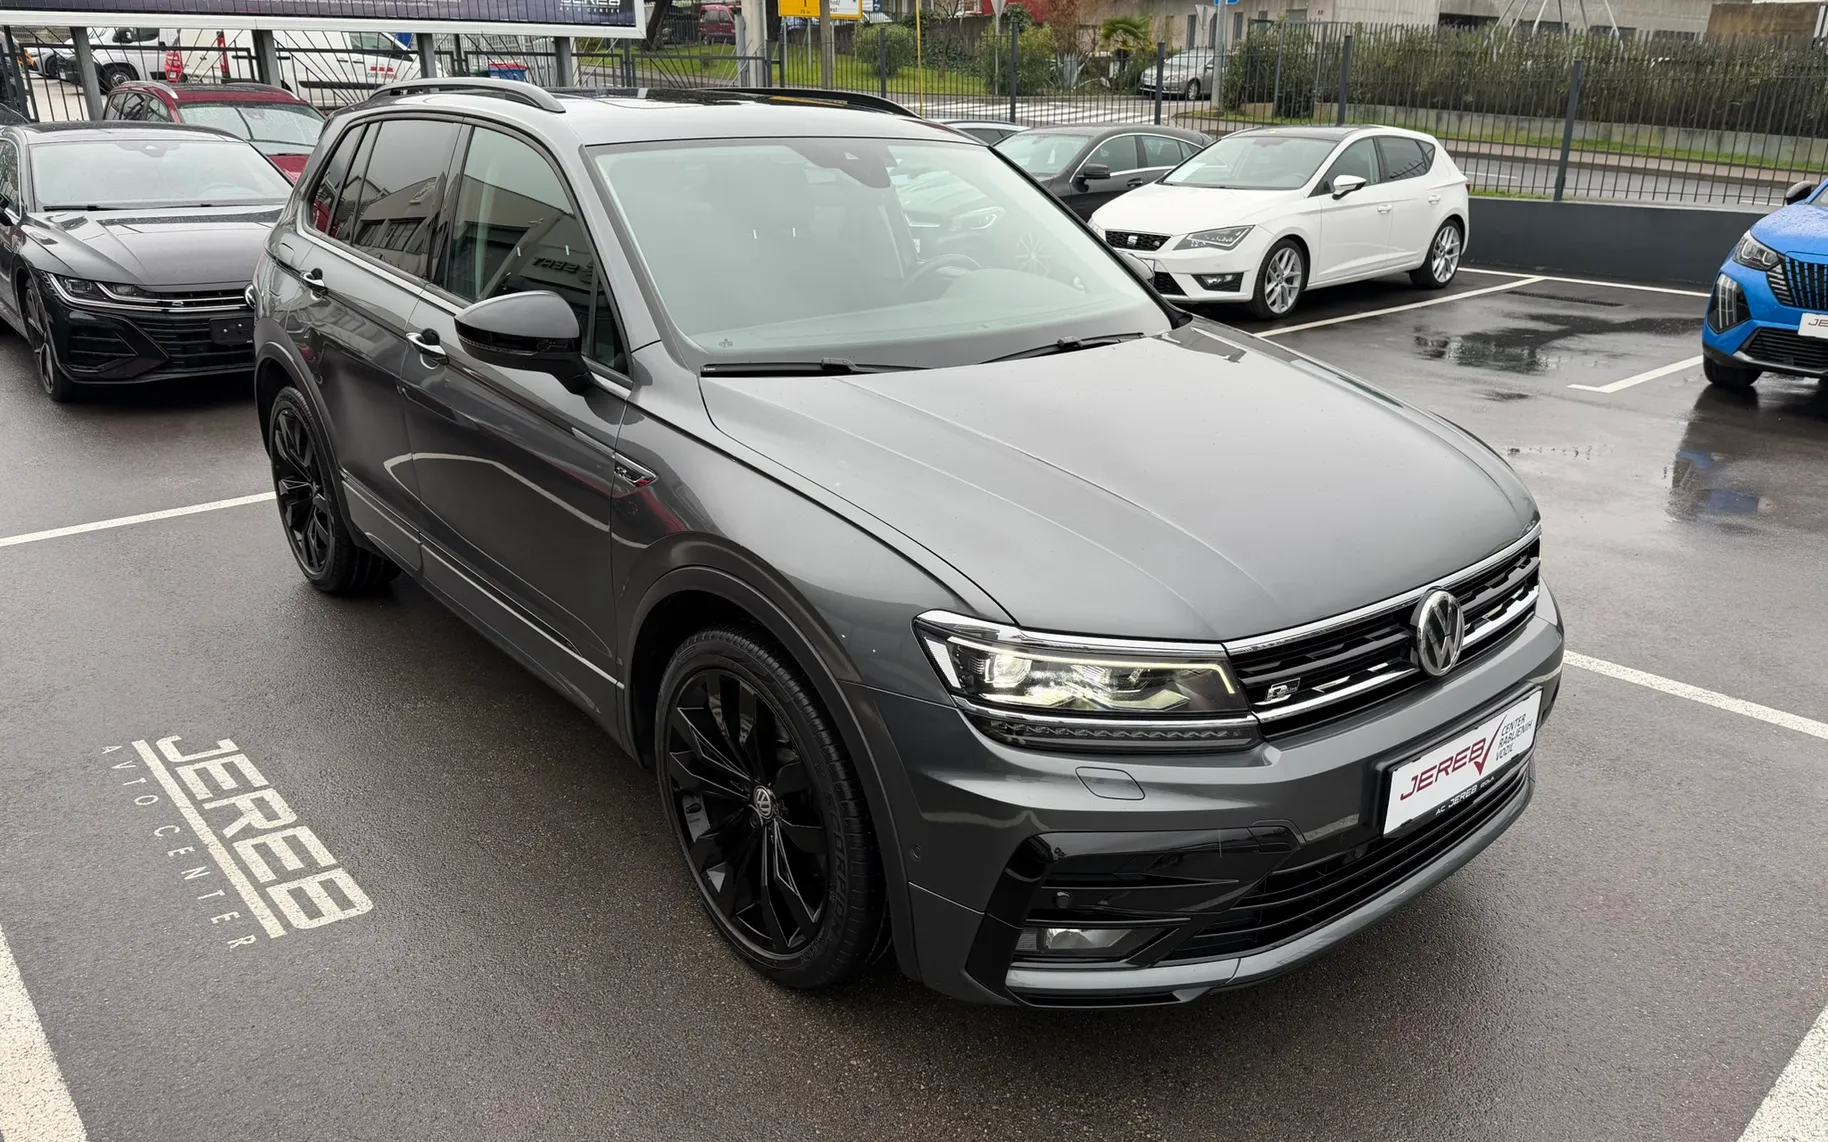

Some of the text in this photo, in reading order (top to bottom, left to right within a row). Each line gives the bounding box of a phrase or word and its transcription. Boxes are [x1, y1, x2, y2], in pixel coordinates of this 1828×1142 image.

[1501, 713, 1527, 737] CENTER
[1400, 737, 1487, 801] JEREB
[1435, 804, 1446, 815] AC
[1448, 784, 1478, 808] JEREB
[101, 745, 257, 949] AVTO CENTER
[156, 735, 374, 930] JEREB
